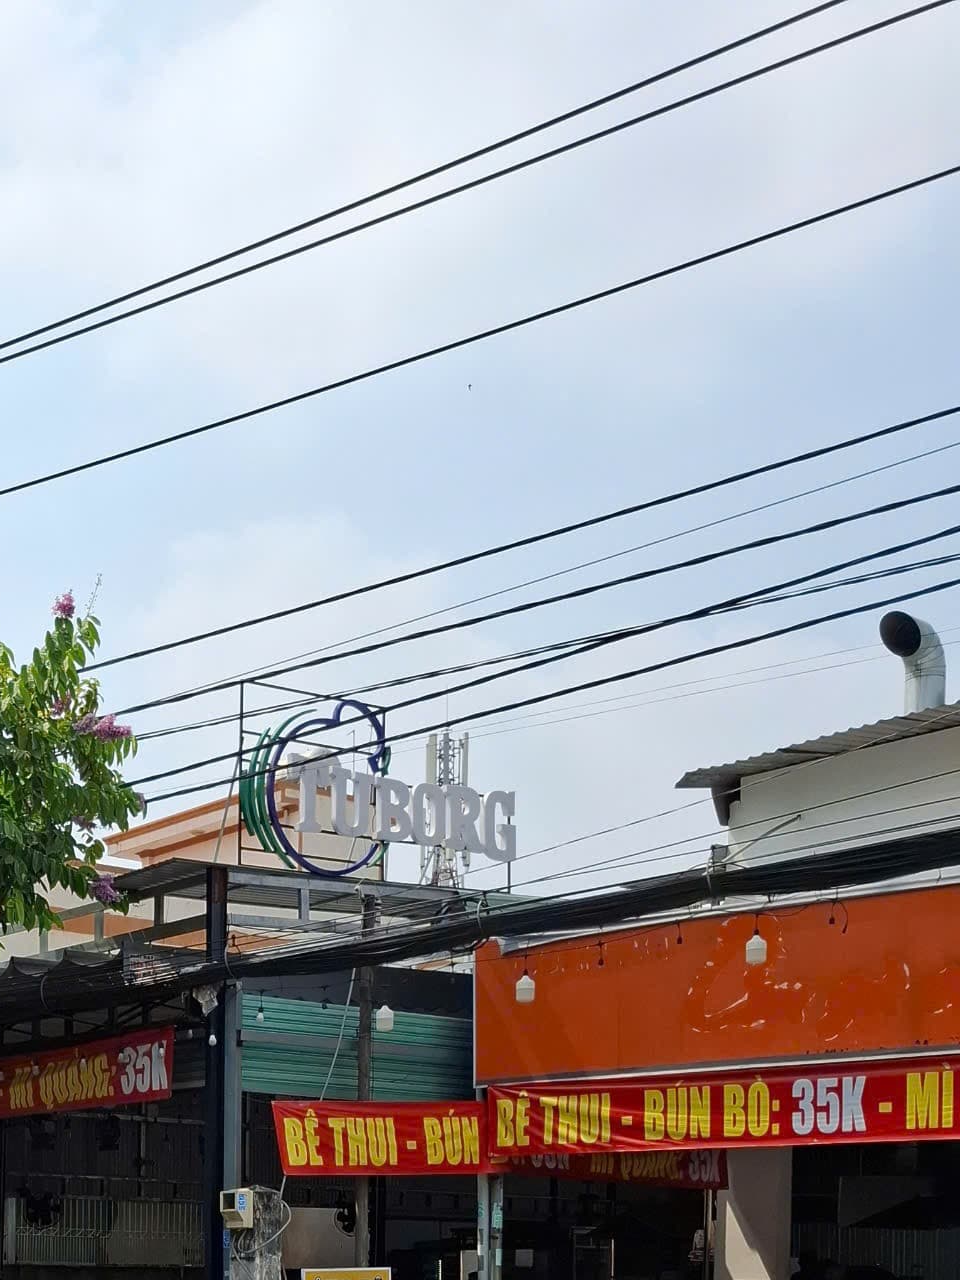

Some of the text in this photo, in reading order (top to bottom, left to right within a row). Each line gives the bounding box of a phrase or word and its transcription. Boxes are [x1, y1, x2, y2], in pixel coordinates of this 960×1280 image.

[290, 766, 517, 863] TUBORG
[120, 1040, 168, 1095] 35K
[283, 1107, 323, 1166] BÊ
[327, 1117, 398, 1166] THUI
[423, 1108, 480, 1165] BÚN
[497, 1089, 530, 1148] BÊ
[540, 1092, 610, 1145] THUI
[644, 1080, 710, 1141] BÚN
[723, 1074, 779, 1138] BÒ:
[791, 1075, 867, 1136] 35K
[906, 1062, 954, 1130] MÌ
